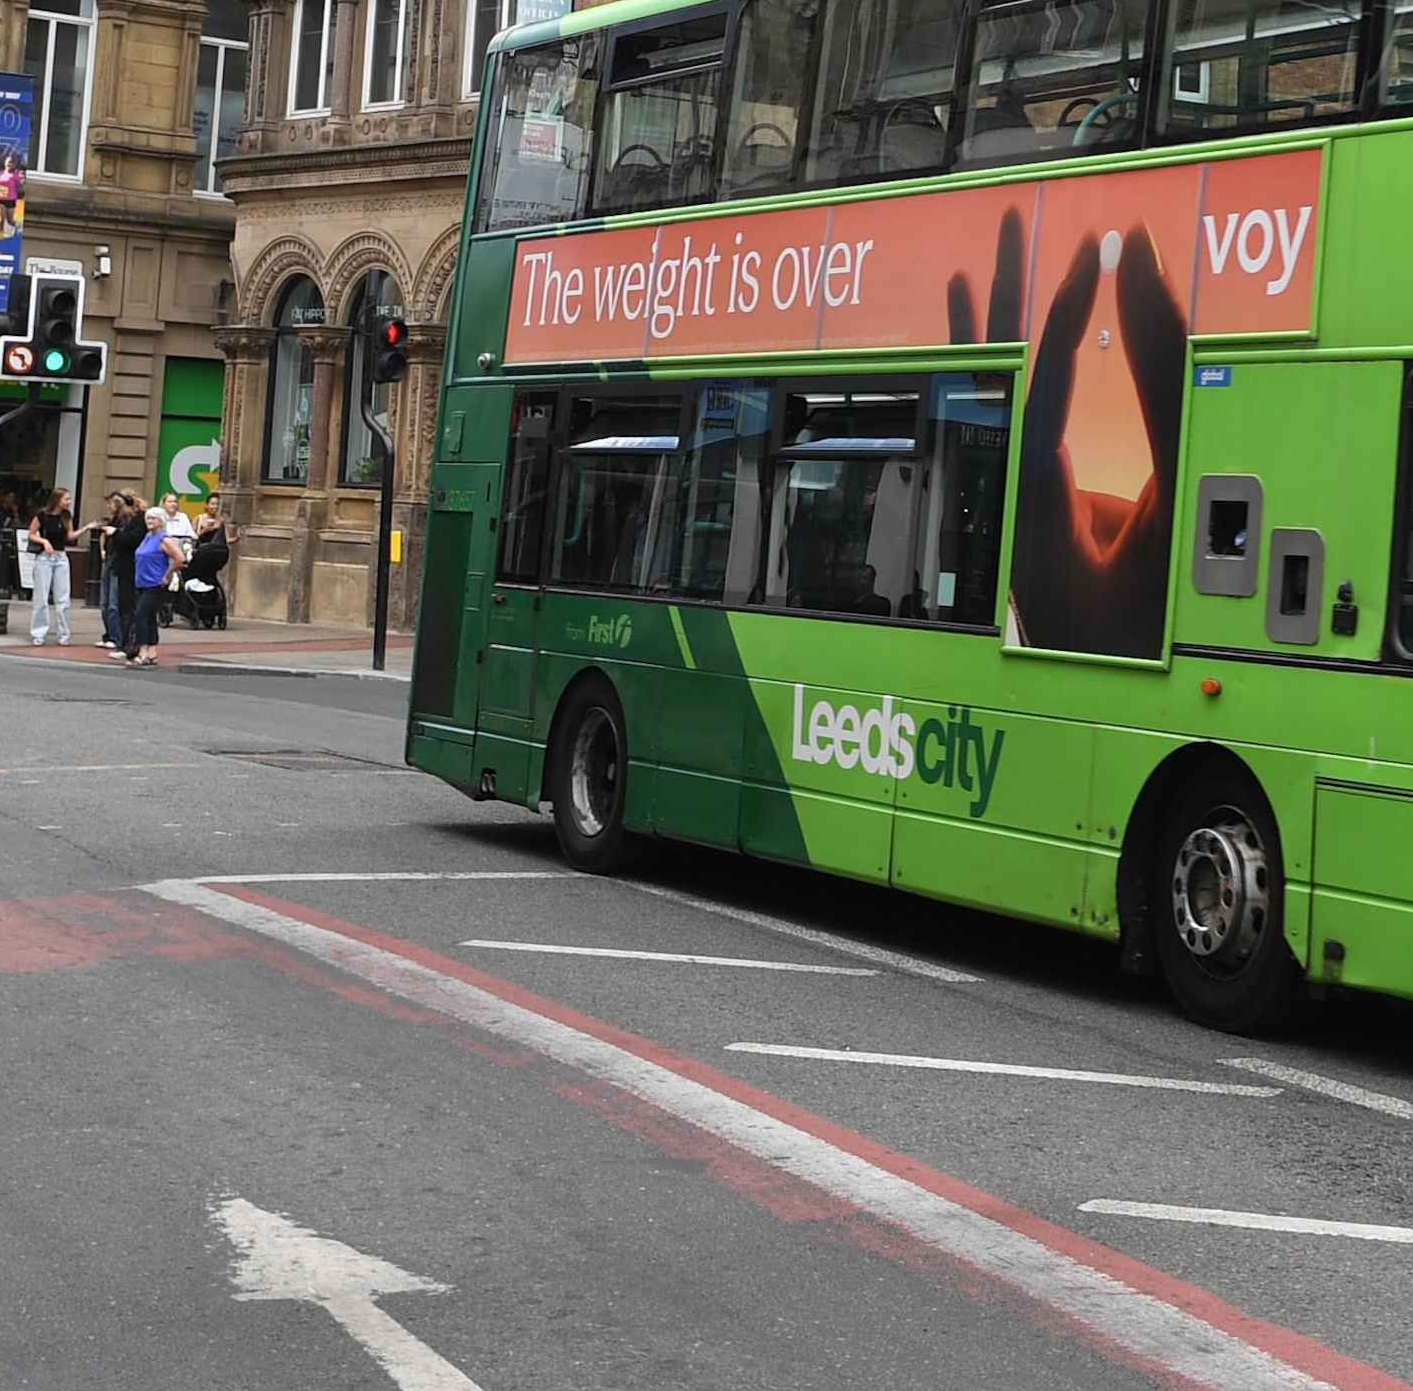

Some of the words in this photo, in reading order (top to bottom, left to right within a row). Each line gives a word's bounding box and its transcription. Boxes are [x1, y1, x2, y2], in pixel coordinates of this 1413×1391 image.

[523, 250, 585, 327] The
[594, 235, 722, 339] weight
[728, 232, 762, 314] is
[770, 239, 874, 312] over
[1202, 206, 1313, 296] voy
[588, 615, 614, 645] First
